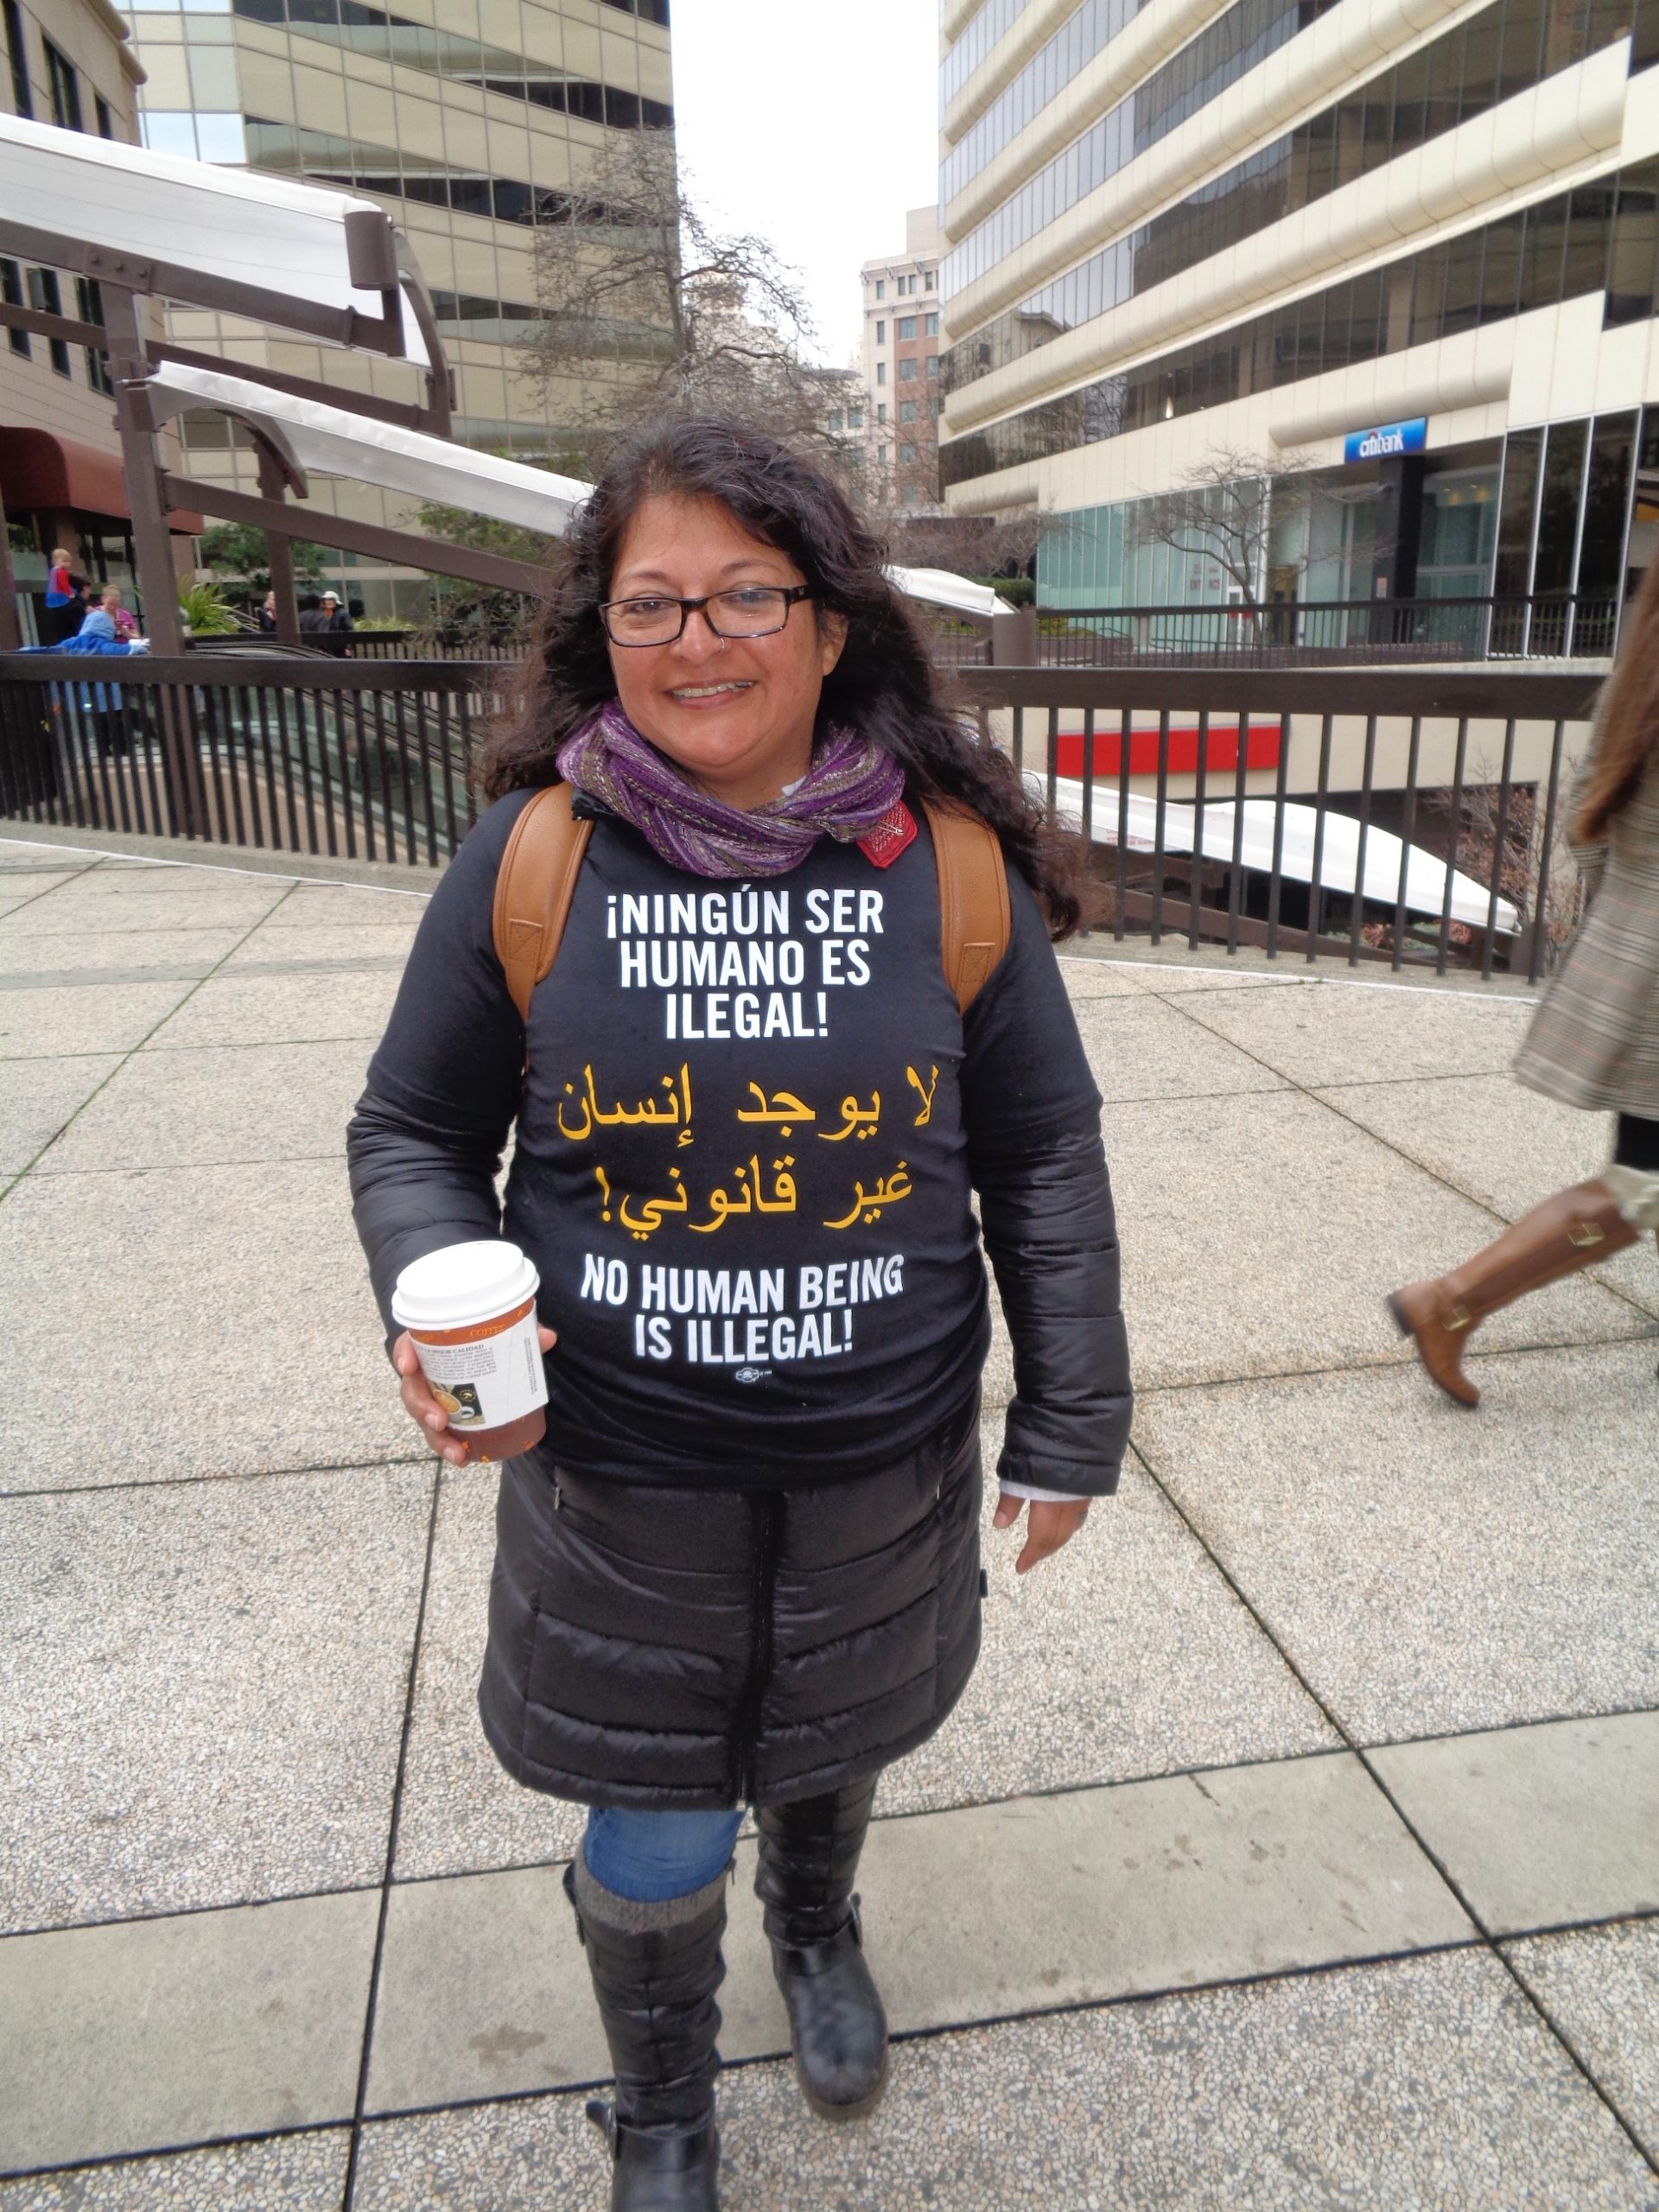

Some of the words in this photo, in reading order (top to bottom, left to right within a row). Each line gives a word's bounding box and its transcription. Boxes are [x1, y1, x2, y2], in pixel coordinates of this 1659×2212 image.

[1359, 429, 1403, 457] citibank
[607, 883, 790, 939] ¡NINGÚN
[804, 888, 884, 934] SER
[620, 939, 804, 988] HUMANO
[822, 938, 871, 987] ES
[666, 991, 829, 1039] ILEGAL!
[557, 1062, 695, 1148] إنسان
[906, 1065, 939, 1127] لا
[823, 1159, 913, 1230] غير
[580, 1253, 628, 1306] NO
[640, 1264, 785, 1316] HUMAN
[798, 1254, 904, 1310] BEING
[635, 1313, 672, 1359] IS
[687, 1308, 853, 1363] ILLEGAL!
